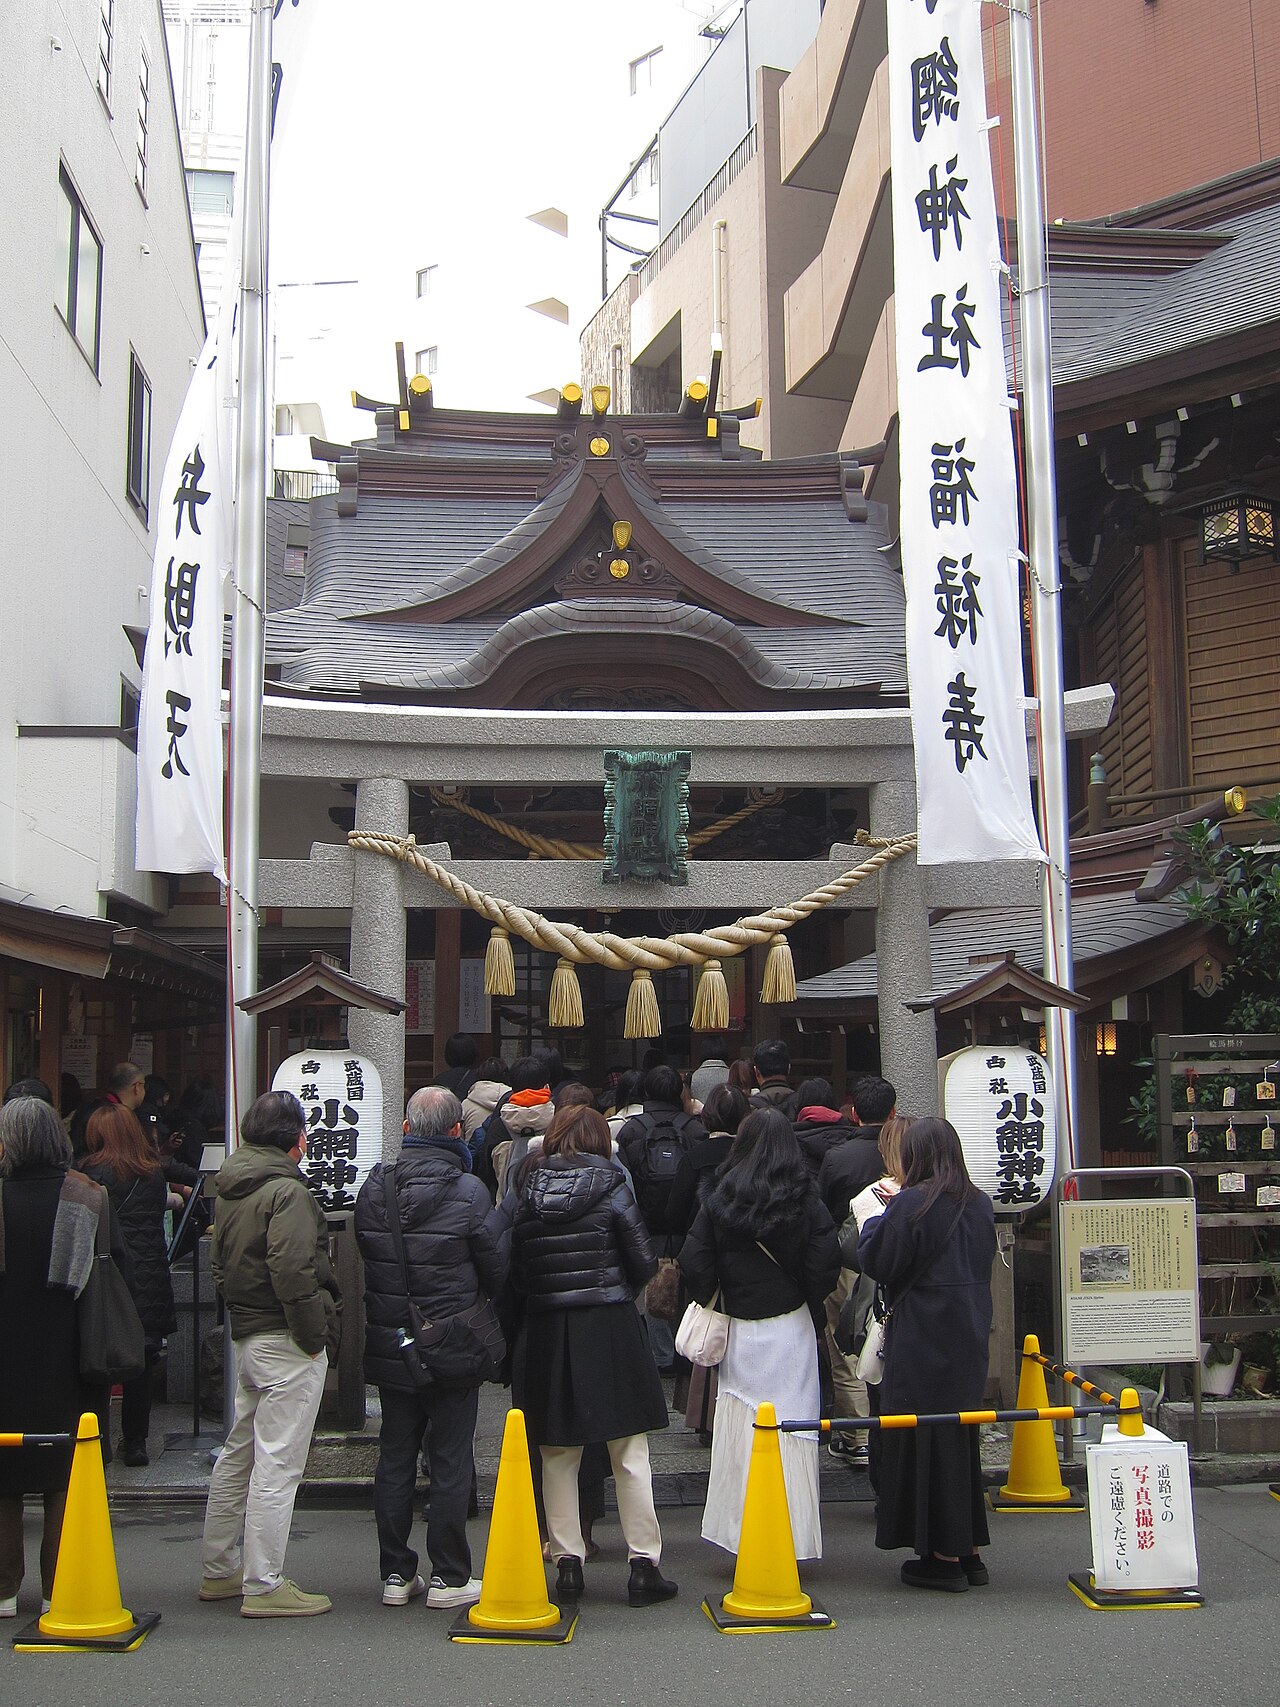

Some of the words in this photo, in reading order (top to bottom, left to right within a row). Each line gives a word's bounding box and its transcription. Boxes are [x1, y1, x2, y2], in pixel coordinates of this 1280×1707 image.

[343, 1059, 364, 1102] 武蔵国
[1025, 1055, 1047, 1095] 武蔵国
[993, 1092, 1046, 1204] 小網神社
[1109, 1465, 1131, 1577] ご遠慮ください。
[1131, 1465, 1155, 1550] 写真撮影
[1157, 1463, 1174, 1523] 道路での
